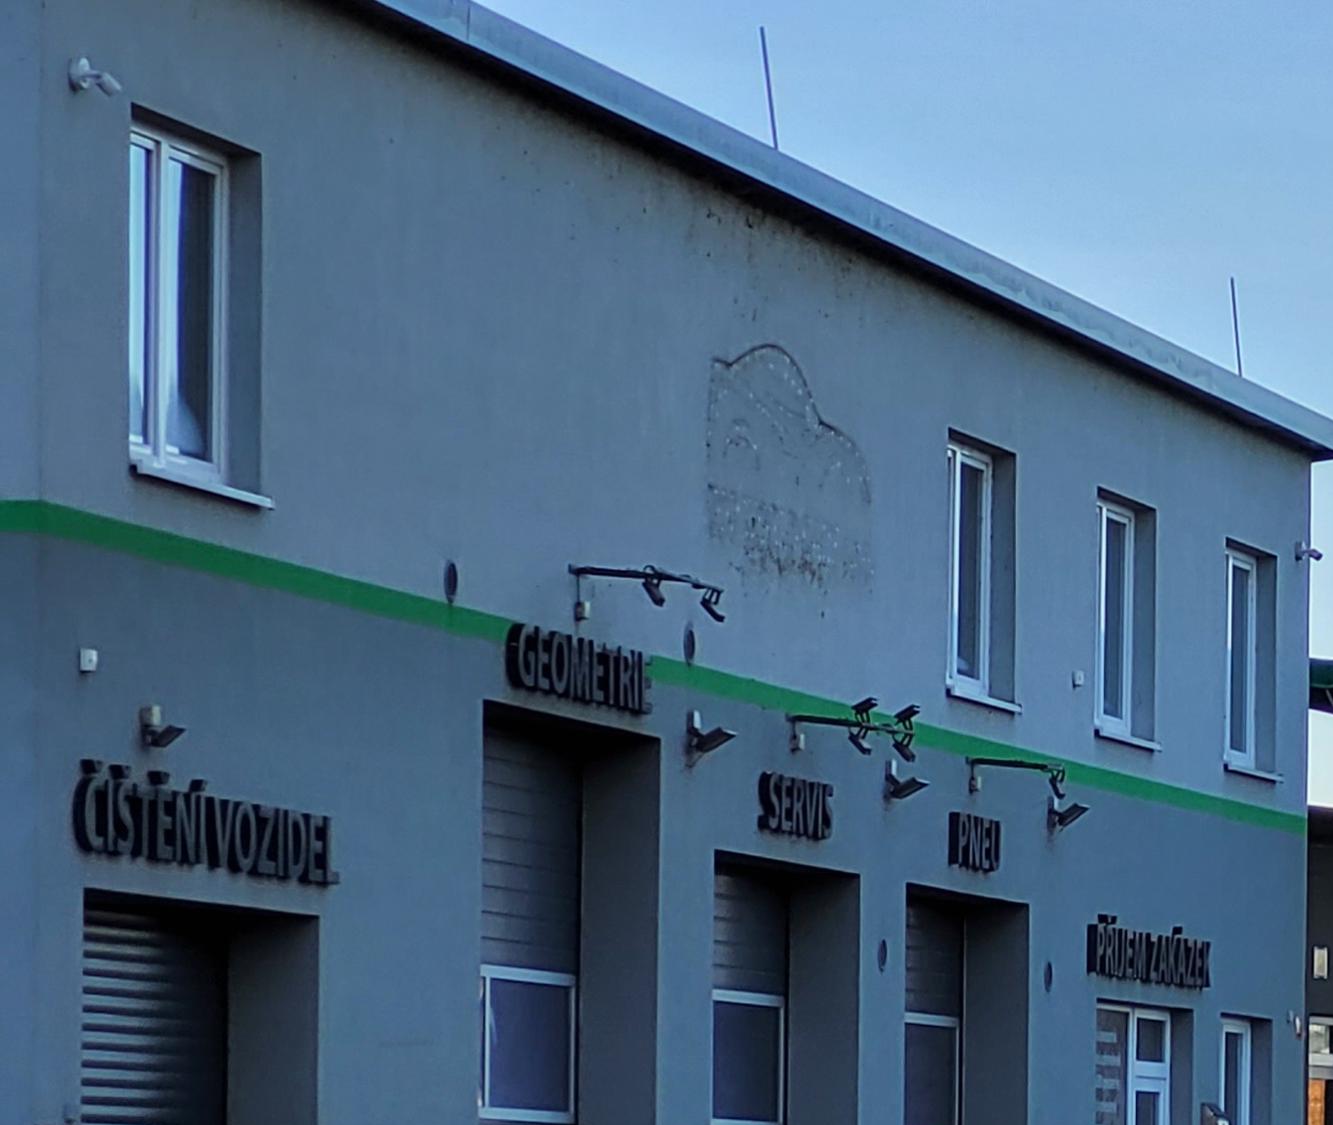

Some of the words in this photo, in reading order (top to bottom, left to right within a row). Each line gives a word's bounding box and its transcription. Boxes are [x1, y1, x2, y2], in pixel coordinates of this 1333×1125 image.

[505, 623, 653, 715] GEOMETRIE
[205, 796, 341, 886] VOZIDEL
[757, 771, 833, 841] SERVIS
[948, 811, 1003, 873] PNEU
